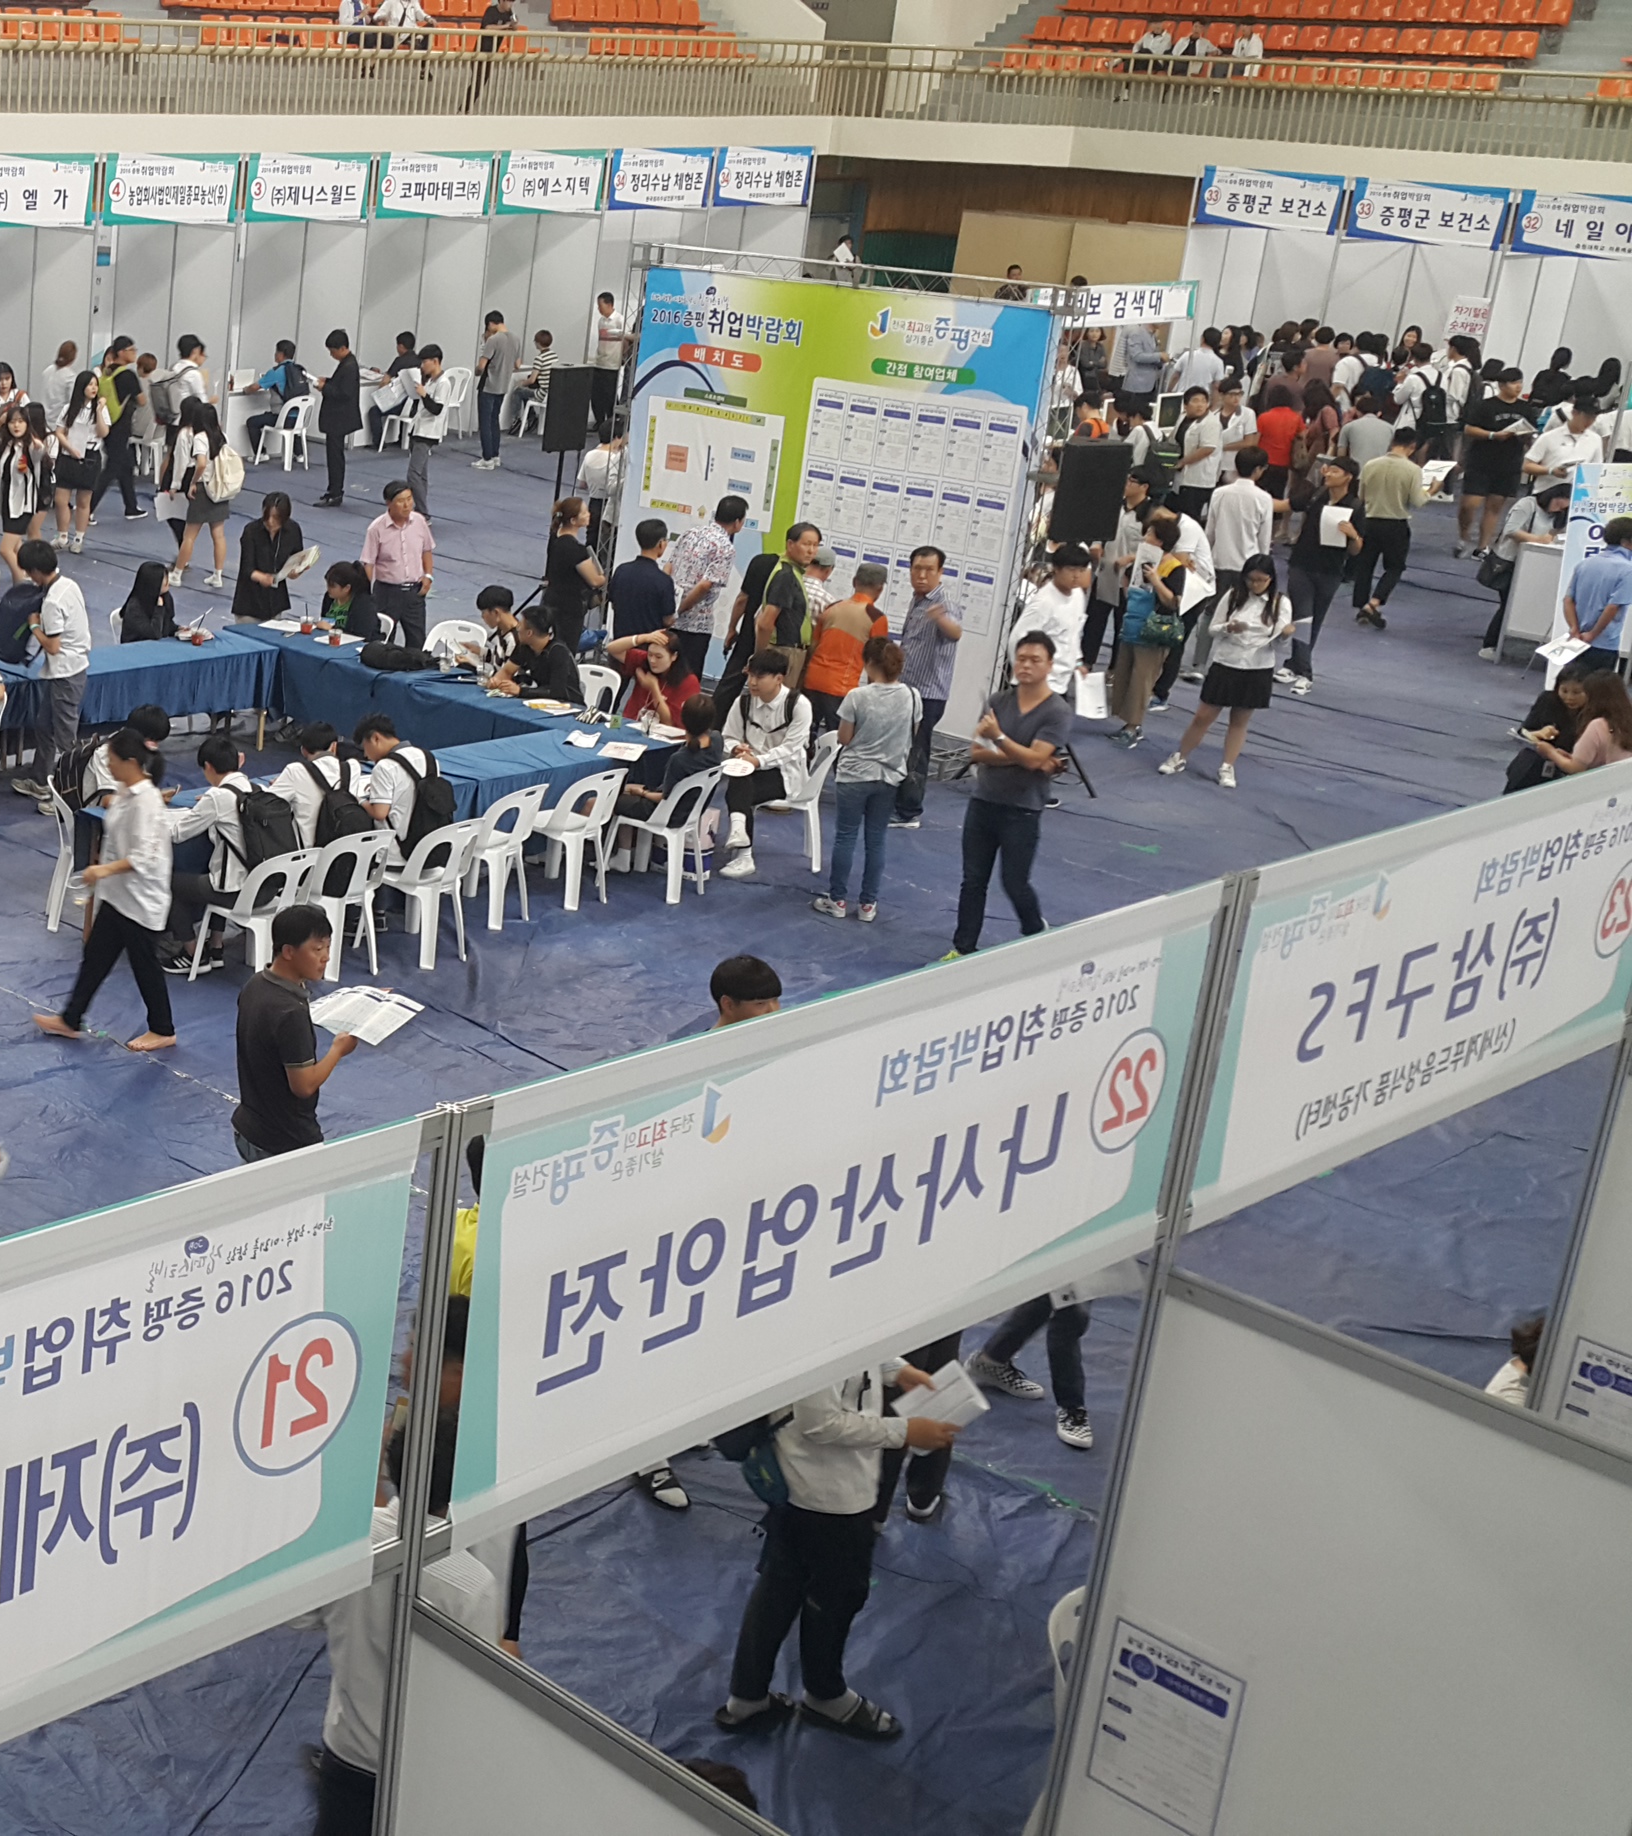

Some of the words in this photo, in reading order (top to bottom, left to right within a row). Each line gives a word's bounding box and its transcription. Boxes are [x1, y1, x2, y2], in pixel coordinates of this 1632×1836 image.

[141, 166, 174, 176] 취업박람회
[281, 165, 311, 174] 취업박람회
[506, 177, 510, 189] 1
[616, 172, 625, 188] 34
[630, 172, 671, 192] 정리수납
[674, 171, 703, 191] 체험존
[720, 171, 729, 185] 34
[735, 171, 773, 189] 정리수납
[775, 170, 803, 188] 체험존
[112, 182, 120, 196] 4
[254, 182, 262, 196] 3
[385, 179, 392, 192] 2
[399, 181, 480, 201] 코파마테크(주)
[523, 177, 590, 197] (주)에스지텍
[271, 185, 356, 206] (주)제니스월드
[1207, 190, 1219, 202] 33
[1392, 191, 1431, 201] 취업박람회
[1227, 193, 1272, 214] 증평군
[1280, 198, 1327, 218] 보건소
[1358, 203, 1371, 215] 33
[1563, 204, 1605, 214] 취업박람회
[1380, 206, 1430, 229] 증평군
[1438, 211, 1490, 232] 보건소
[1524, 216, 1539, 229] 32
[1114, 289, 1163, 318] 검색대
[652, 309, 680, 323] 2016
[684, 311, 704, 328] 증평
[707, 308, 803, 346] 취업박람회
[886, 362, 907, 376] 간접
[913, 366, 958, 382] 참여업체
